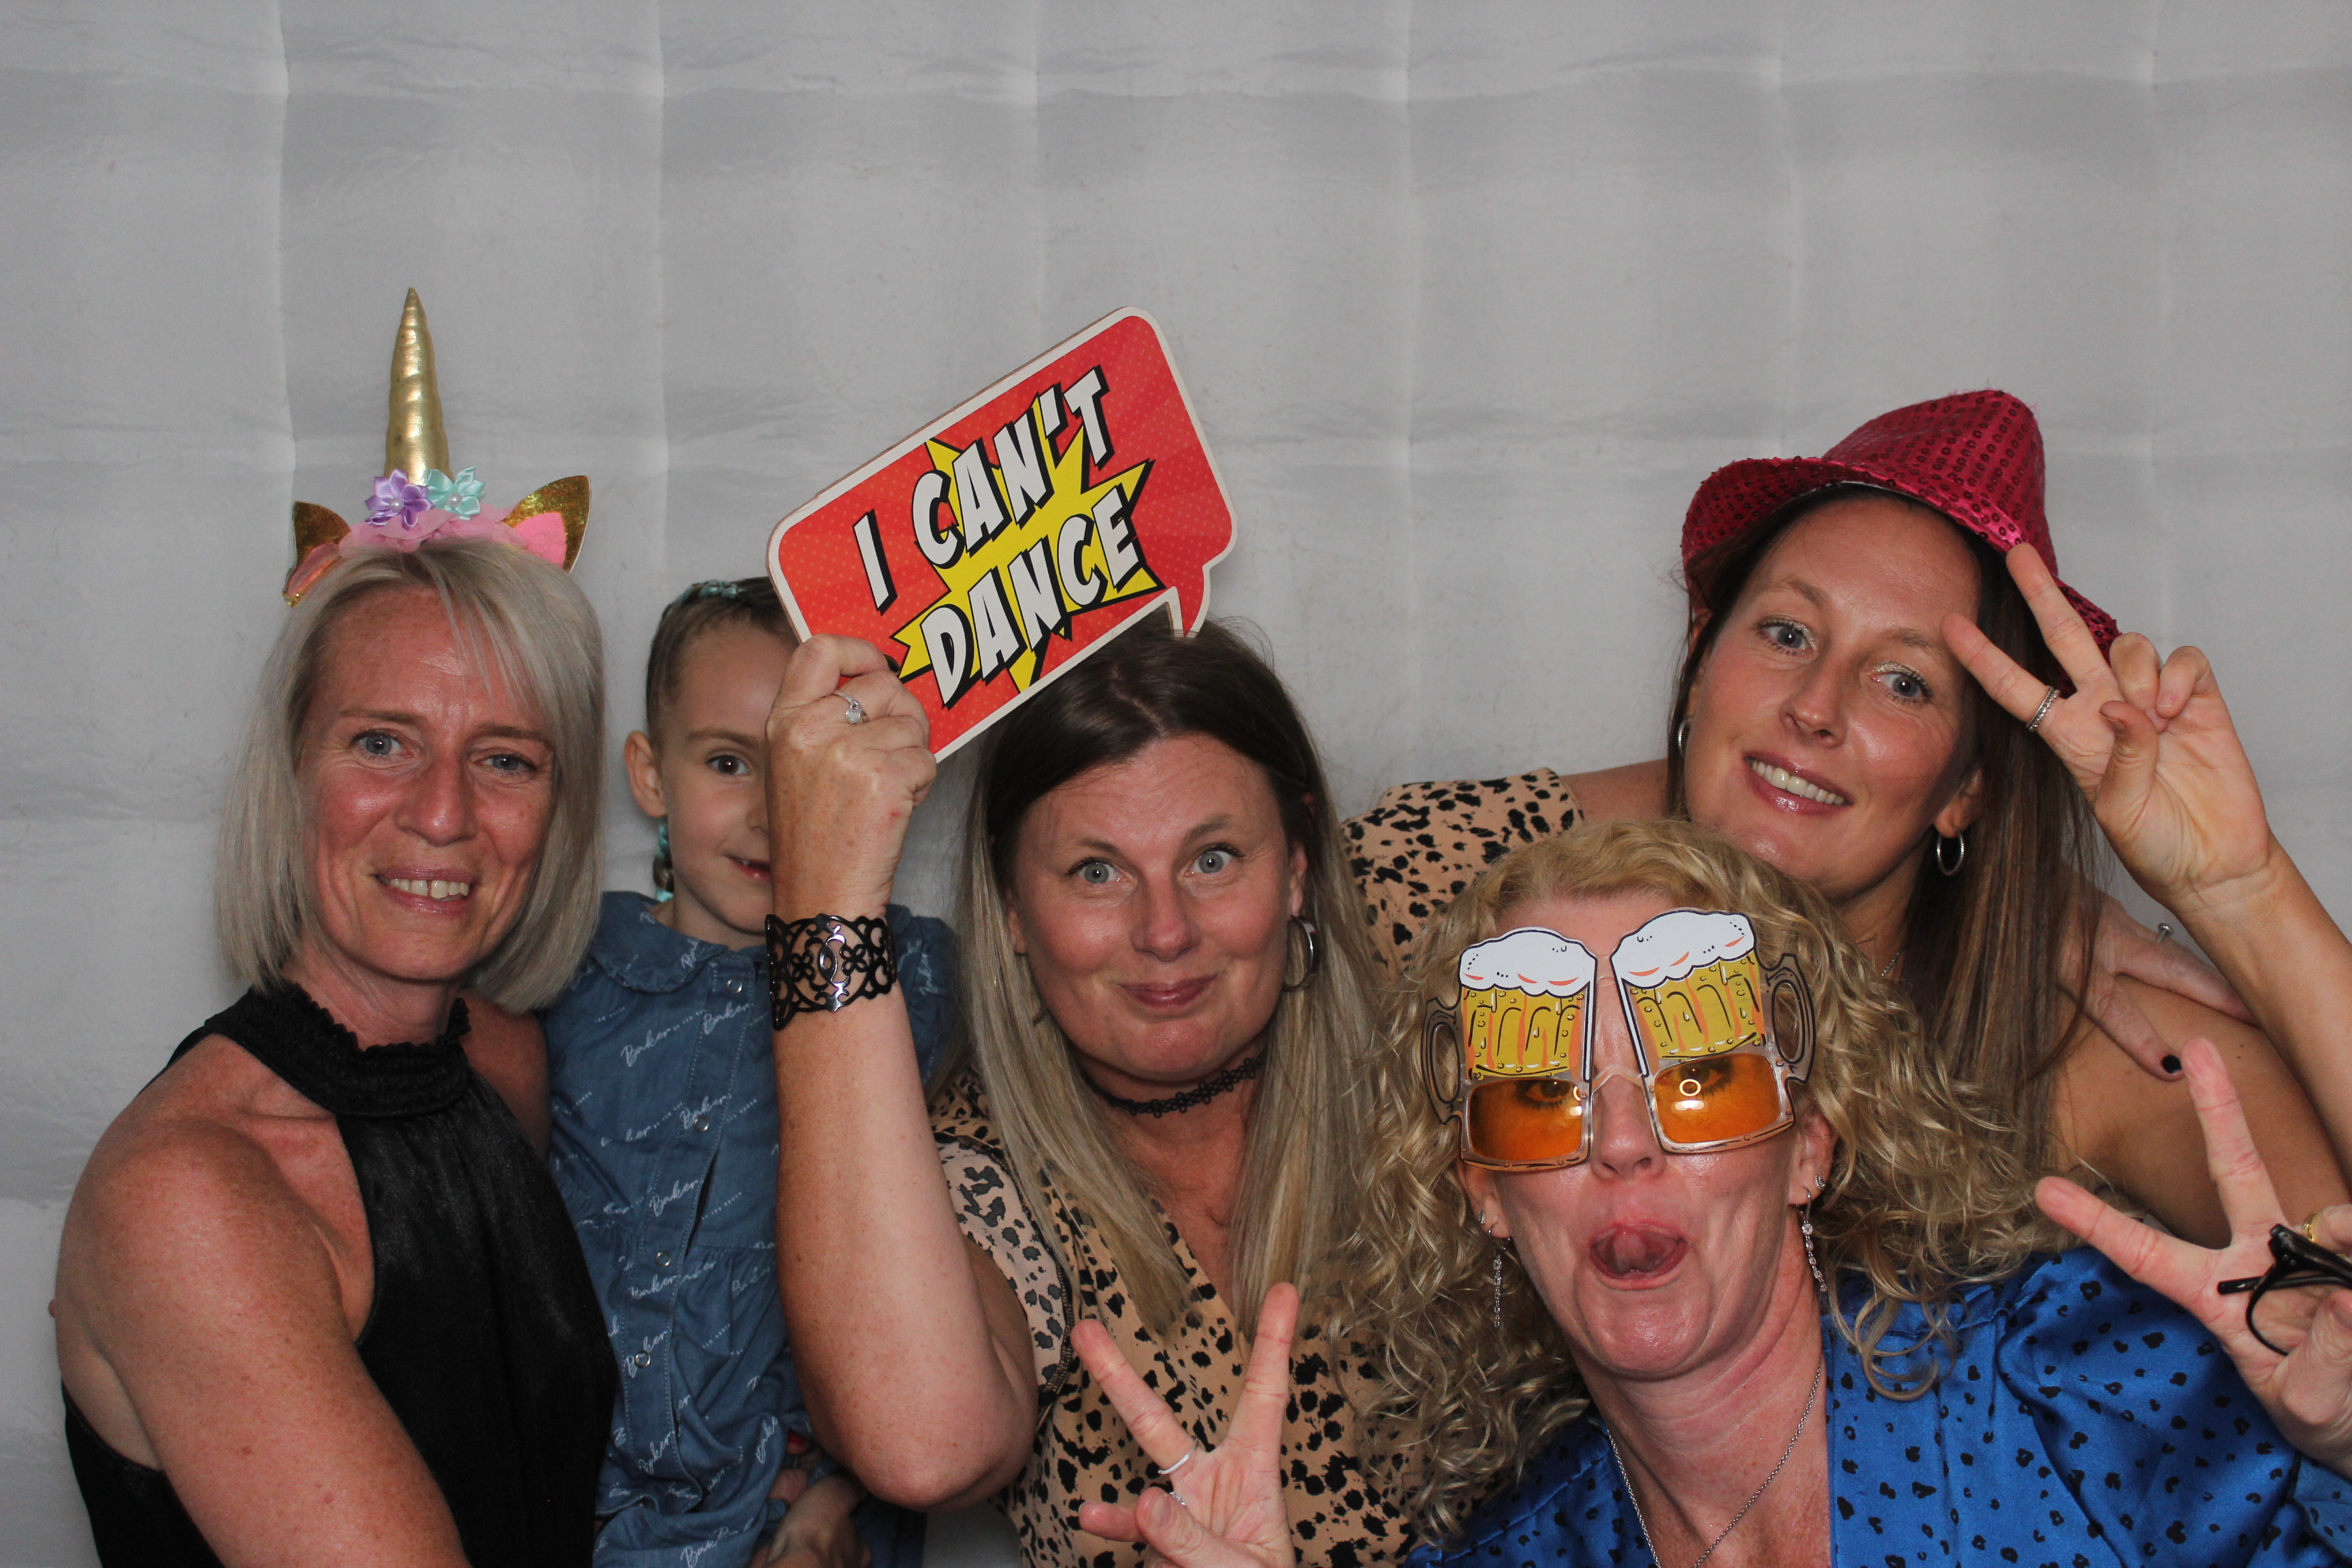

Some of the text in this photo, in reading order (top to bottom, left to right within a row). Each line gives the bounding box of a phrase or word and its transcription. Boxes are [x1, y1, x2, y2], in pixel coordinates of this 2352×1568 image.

[853, 364, 1114, 615] I CAN'T
[920, 483, 1145, 710] DANCE
[703, 1001, 749, 1035] Baker
[621, 1029, 671, 1068] Baker
[679, 1096, 728, 1130] Baker
[648, 1179, 699, 1218] Baker
